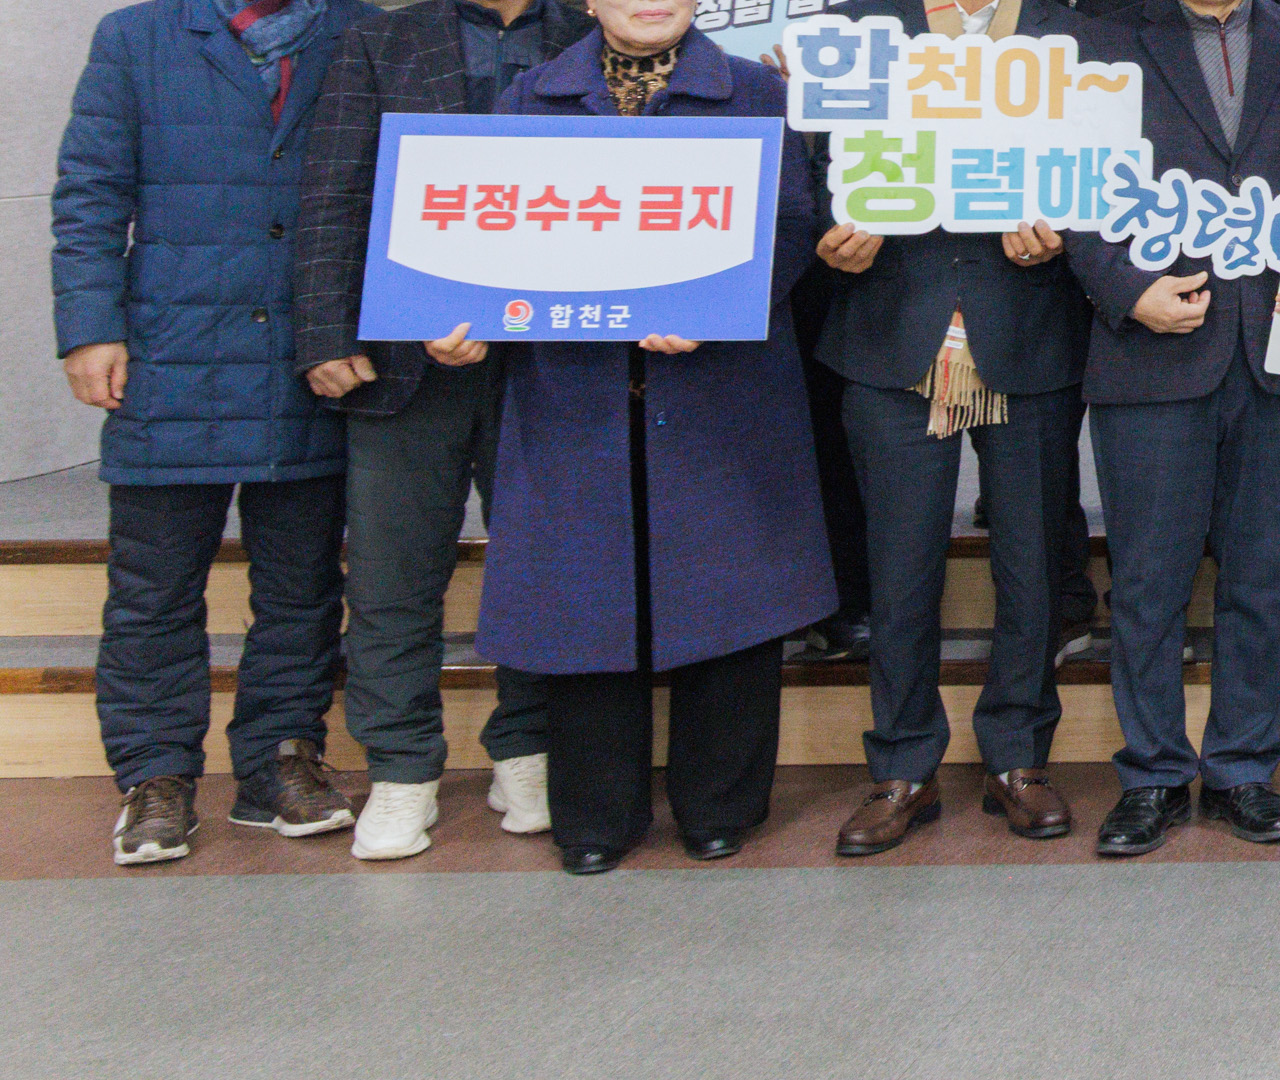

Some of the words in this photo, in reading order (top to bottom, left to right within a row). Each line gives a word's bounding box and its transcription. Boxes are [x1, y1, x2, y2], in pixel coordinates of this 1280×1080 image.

[796, 27, 1131, 120] 합천아~
[421, 184, 622, 232] 부정수수
[638, 185, 734, 232] 금지
[549, 303, 632, 330] 합천군
